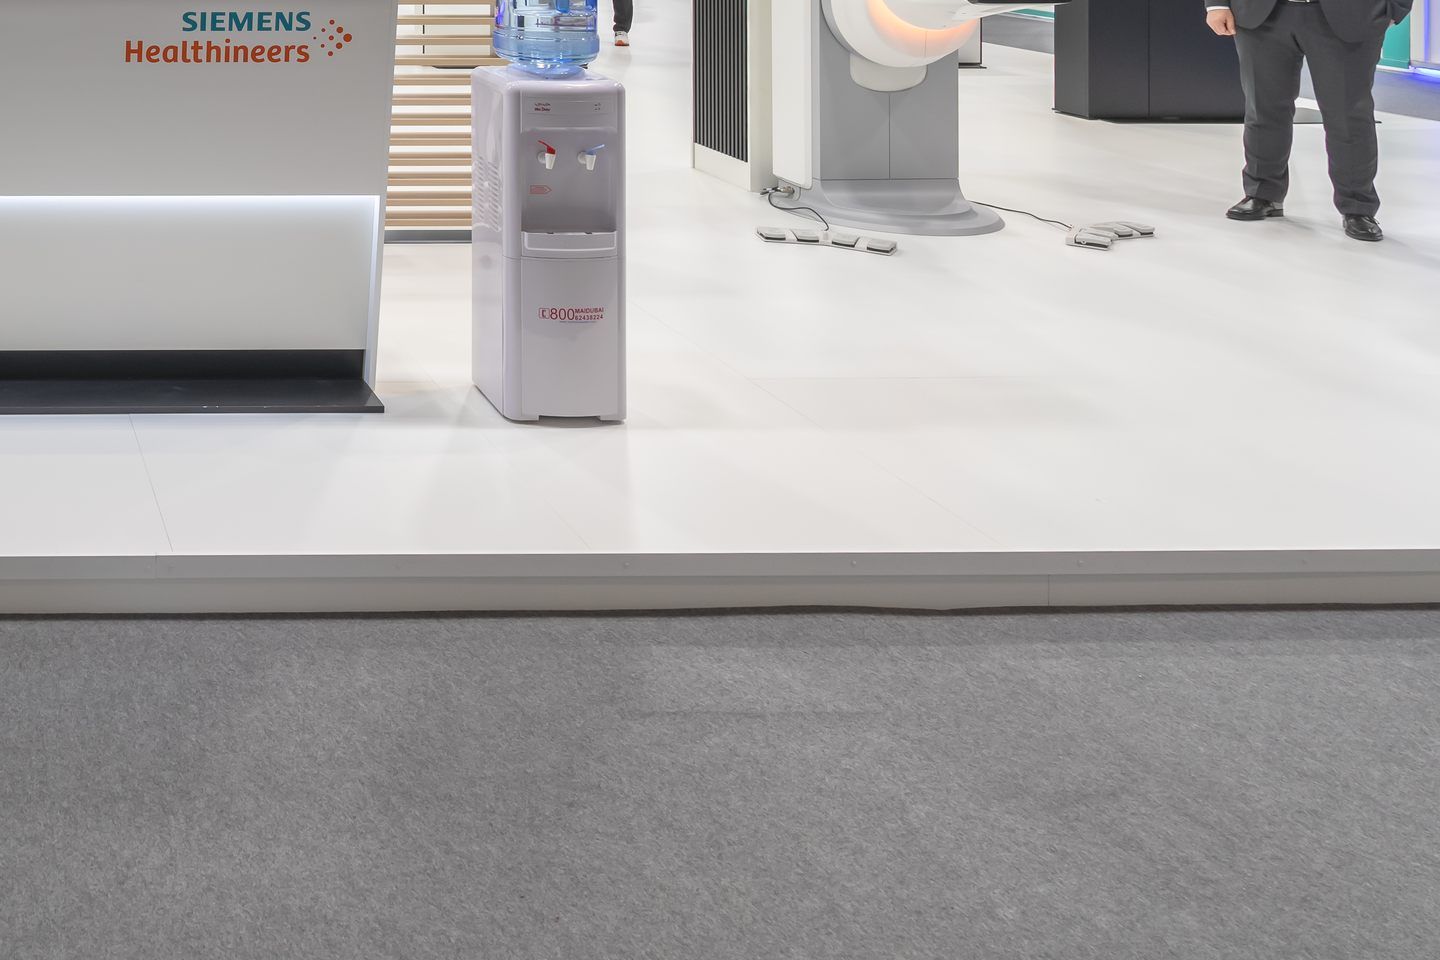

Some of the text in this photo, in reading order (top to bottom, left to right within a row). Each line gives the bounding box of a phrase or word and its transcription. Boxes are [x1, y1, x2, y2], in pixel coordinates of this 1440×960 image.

[181, 10, 312, 33] SIEMENS
[124, 38, 311, 65] Healthineers
[549, 307, 575, 321] 800
